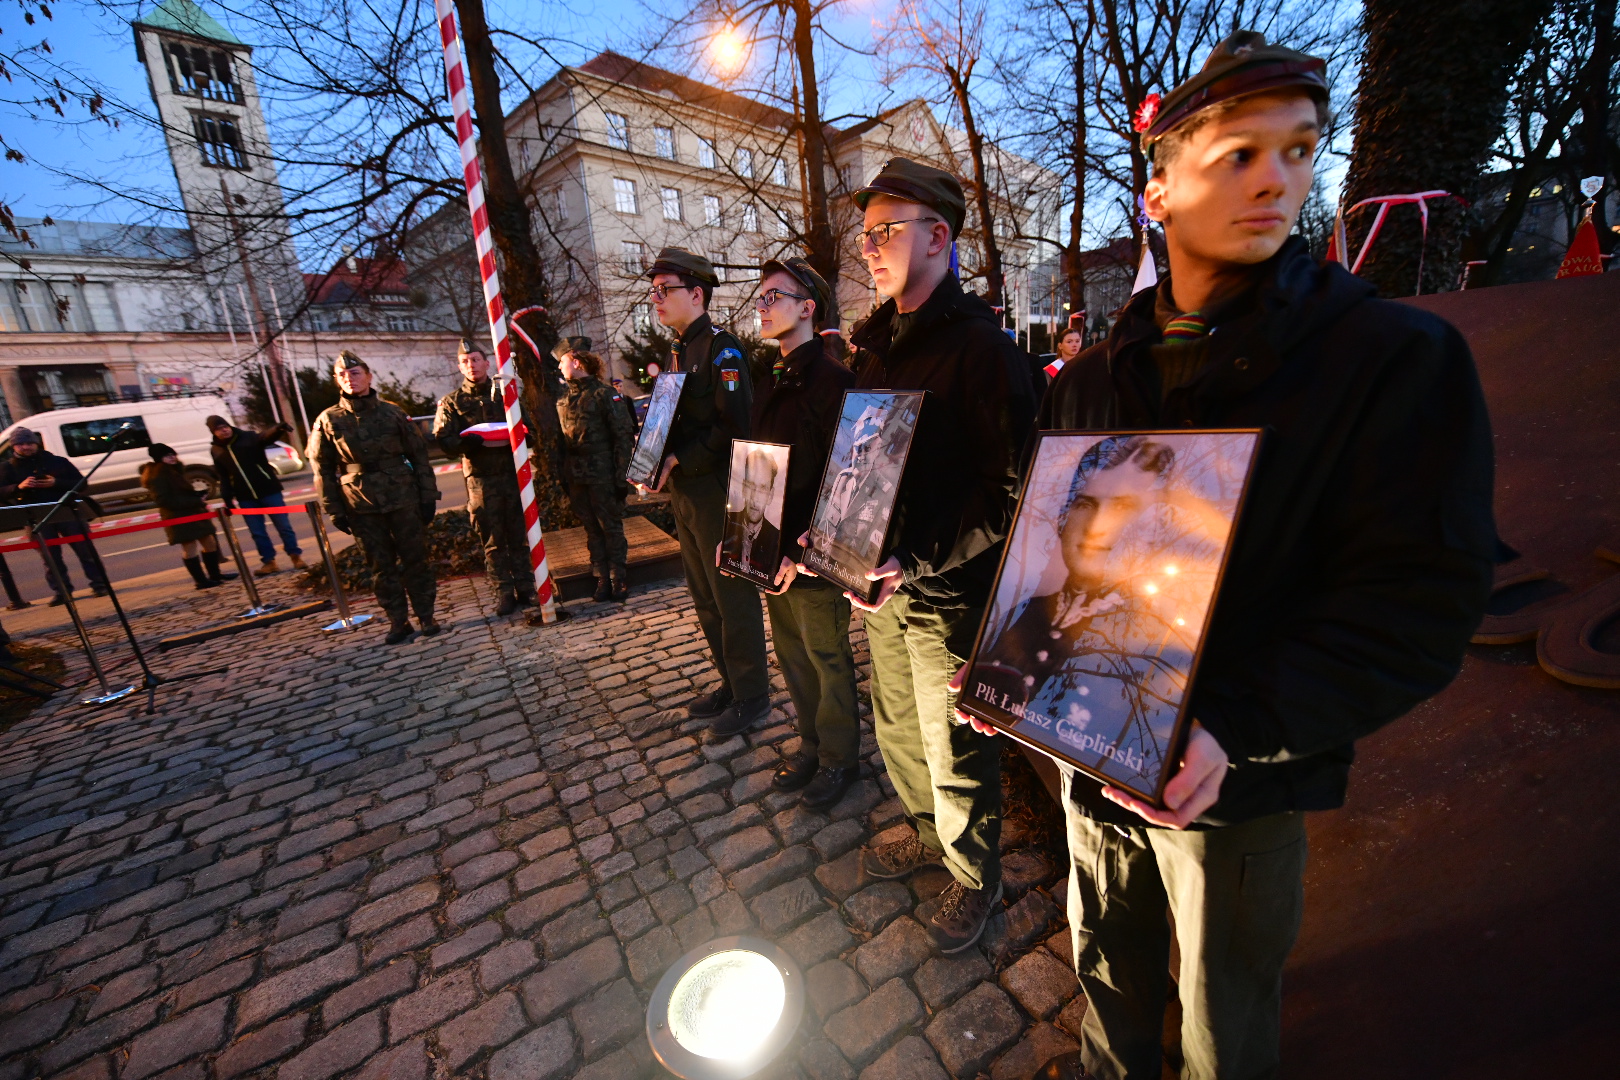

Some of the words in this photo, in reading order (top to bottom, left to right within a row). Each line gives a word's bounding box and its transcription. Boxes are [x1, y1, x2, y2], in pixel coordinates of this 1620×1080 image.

[975, 682, 998, 705] Płk
[1000, 693, 1052, 731] Łukasz
[1055, 718, 1145, 772] Ciepliński
